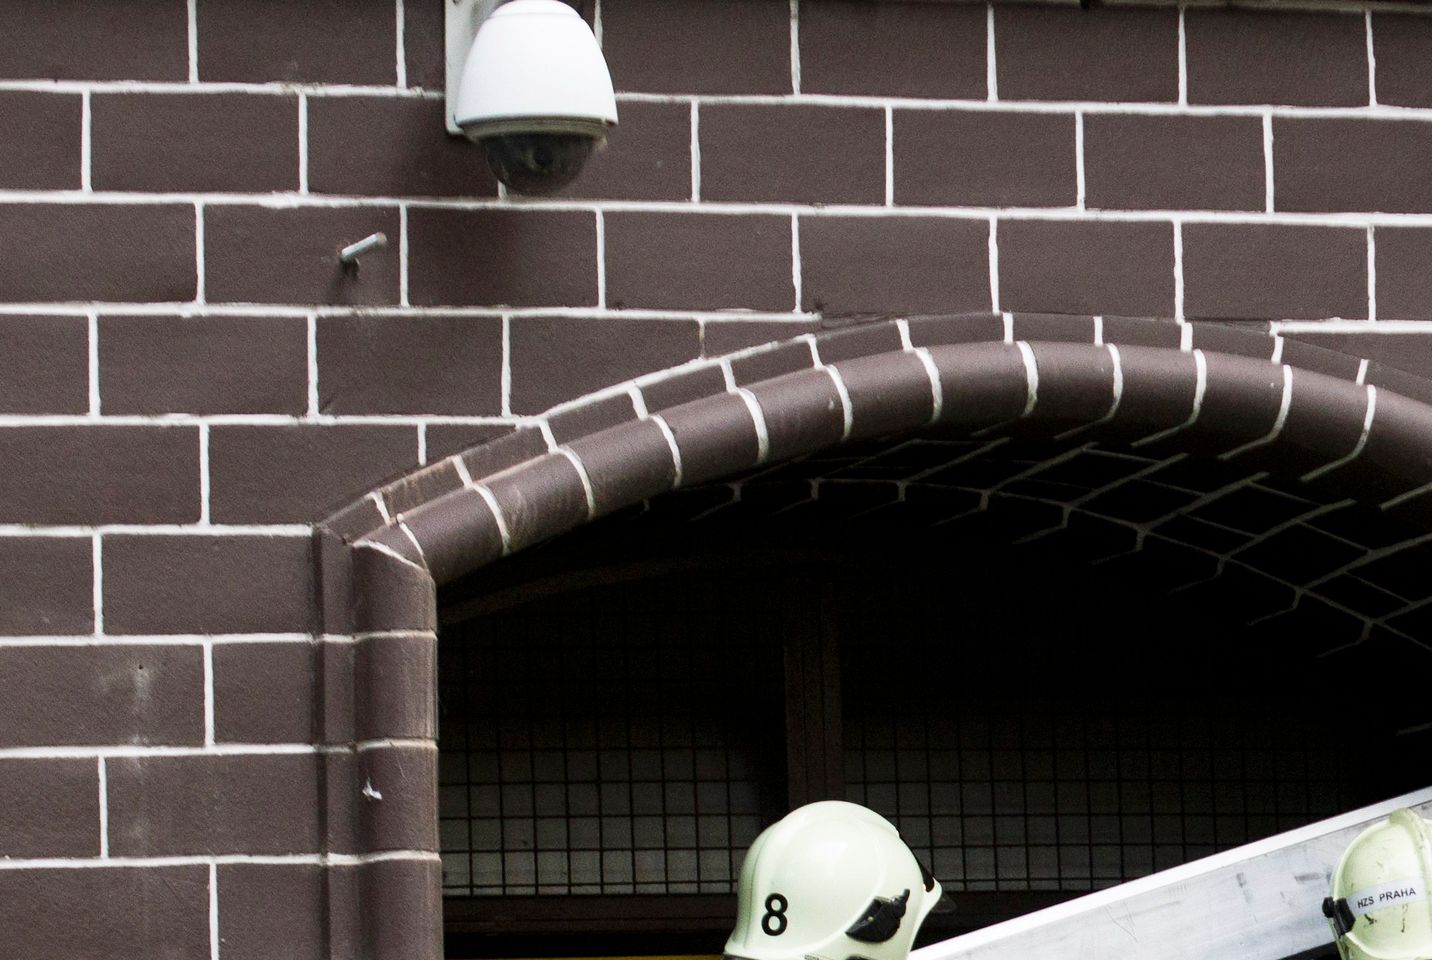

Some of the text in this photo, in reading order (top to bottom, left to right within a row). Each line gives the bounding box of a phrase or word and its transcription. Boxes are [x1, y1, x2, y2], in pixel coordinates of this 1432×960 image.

[1357, 887, 1416, 909] HZS PRAHA
[761, 893, 788, 936] 8
